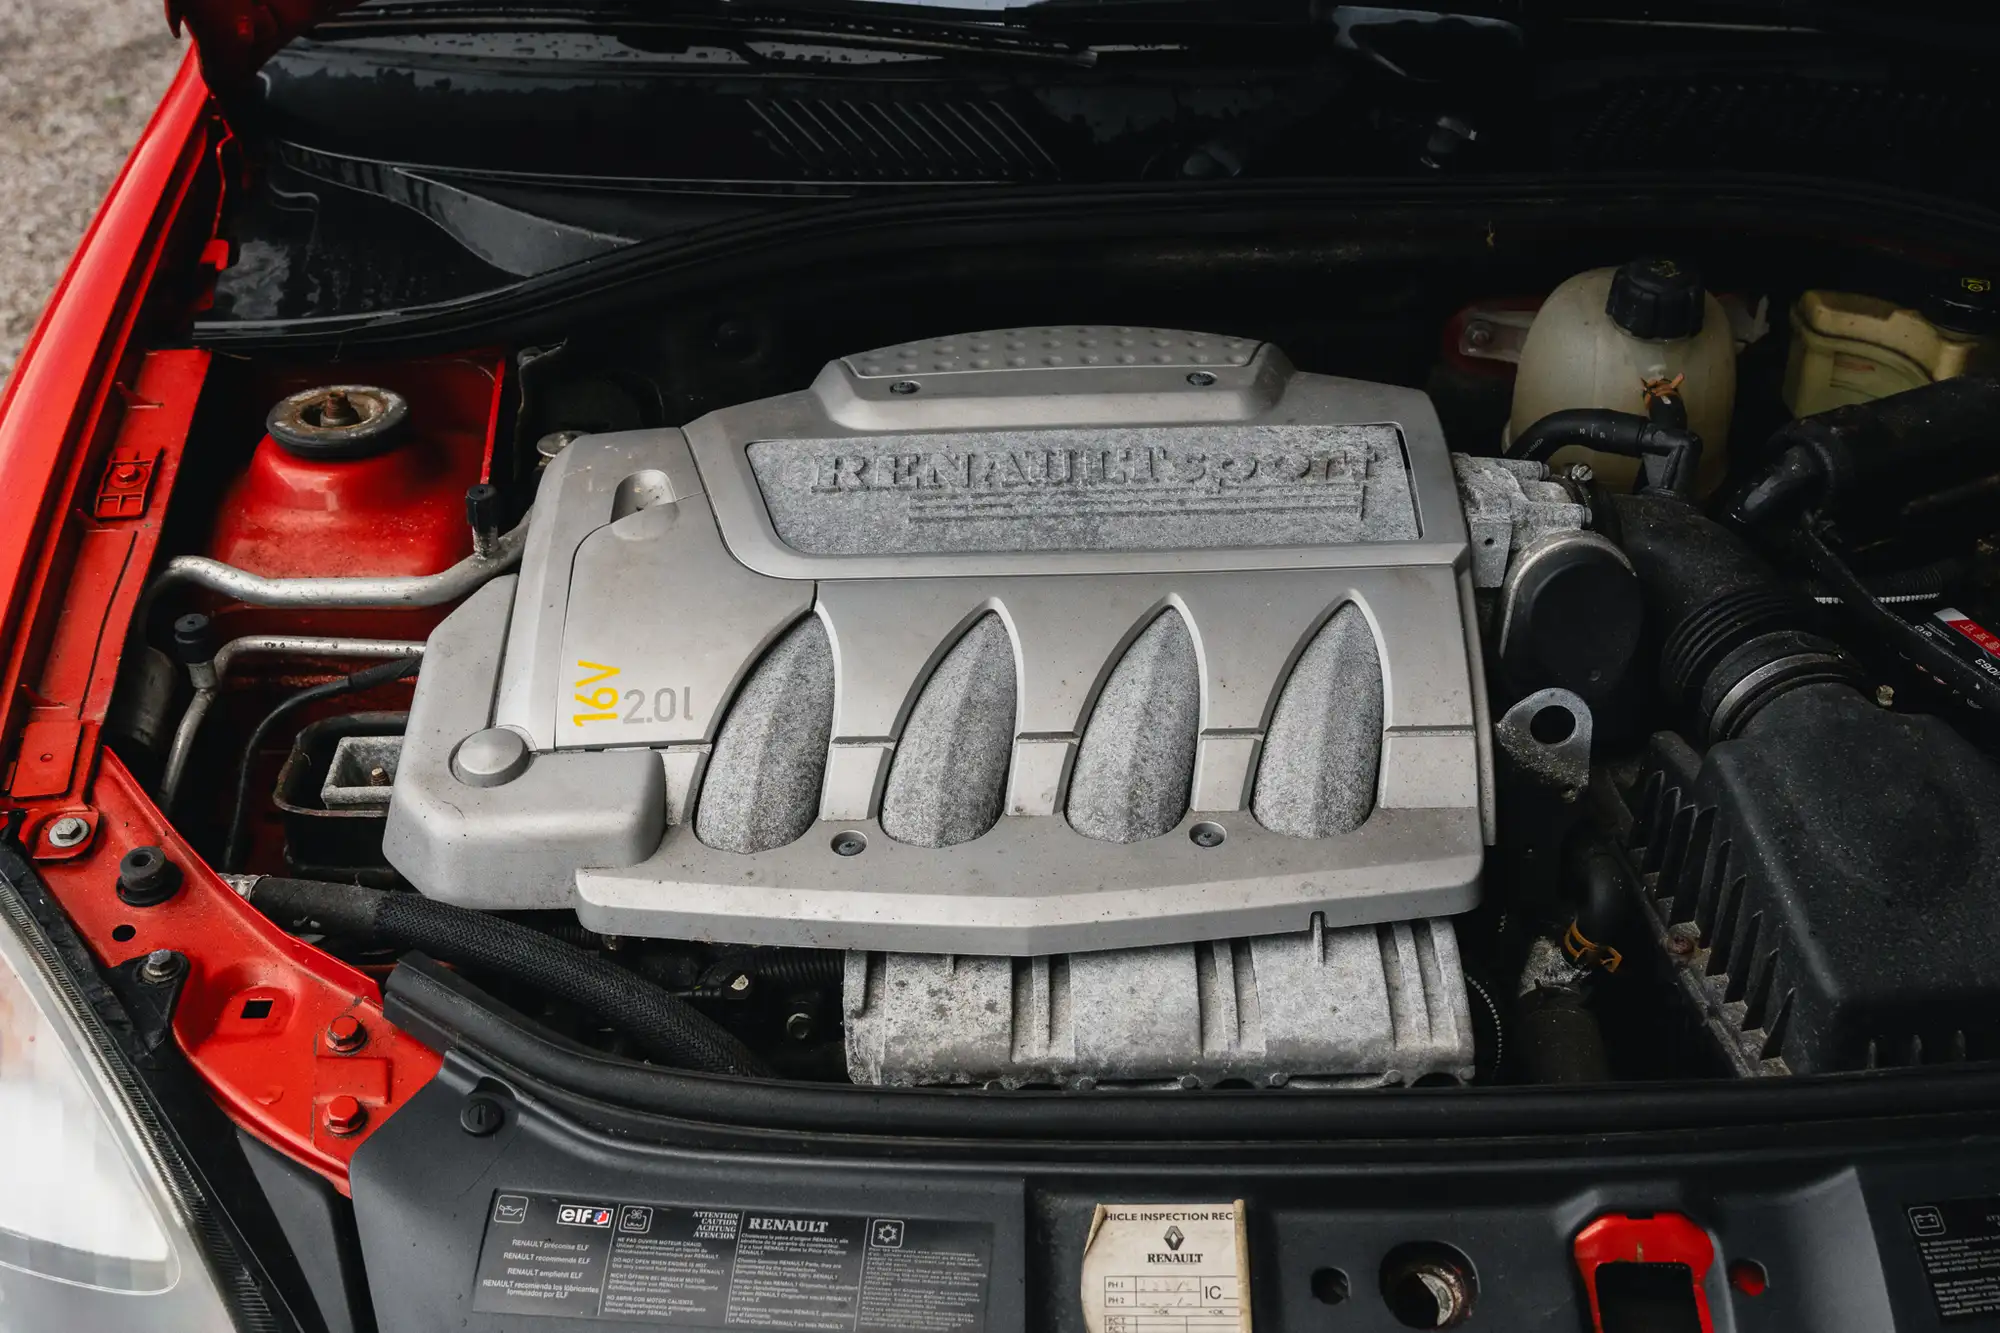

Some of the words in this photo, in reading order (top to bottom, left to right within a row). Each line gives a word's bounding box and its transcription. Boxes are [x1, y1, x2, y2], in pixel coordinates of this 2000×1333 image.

[810, 446, 1170, 493] RENAULT
[573, 660, 621, 727] 16V
[561, 1208, 593, 1223] elf
[692, 1210, 739, 1220] ATTENTION
[1140, 1212, 1209, 1221] INSPECTION
[700, 1217, 738, 1227] CAUTION
[748, 1217, 828, 1234] RENAULT
[696, 1224, 737, 1233] ACHTUNG
[692, 1231, 736, 1240] ATENCION
[511, 1239, 544, 1248] RENAULT
[576, 1244, 590, 1252] ELF
[503, 1251, 535, 1261] RENAULT
[577, 1257, 591, 1265] ELF
[1147, 1253, 1204, 1264] RENAULT
[507, 1267, 540, 1276] RENAULT
[482, 1279, 515, 1288] RENAULT
[555, 1291, 569, 1299] ELF
